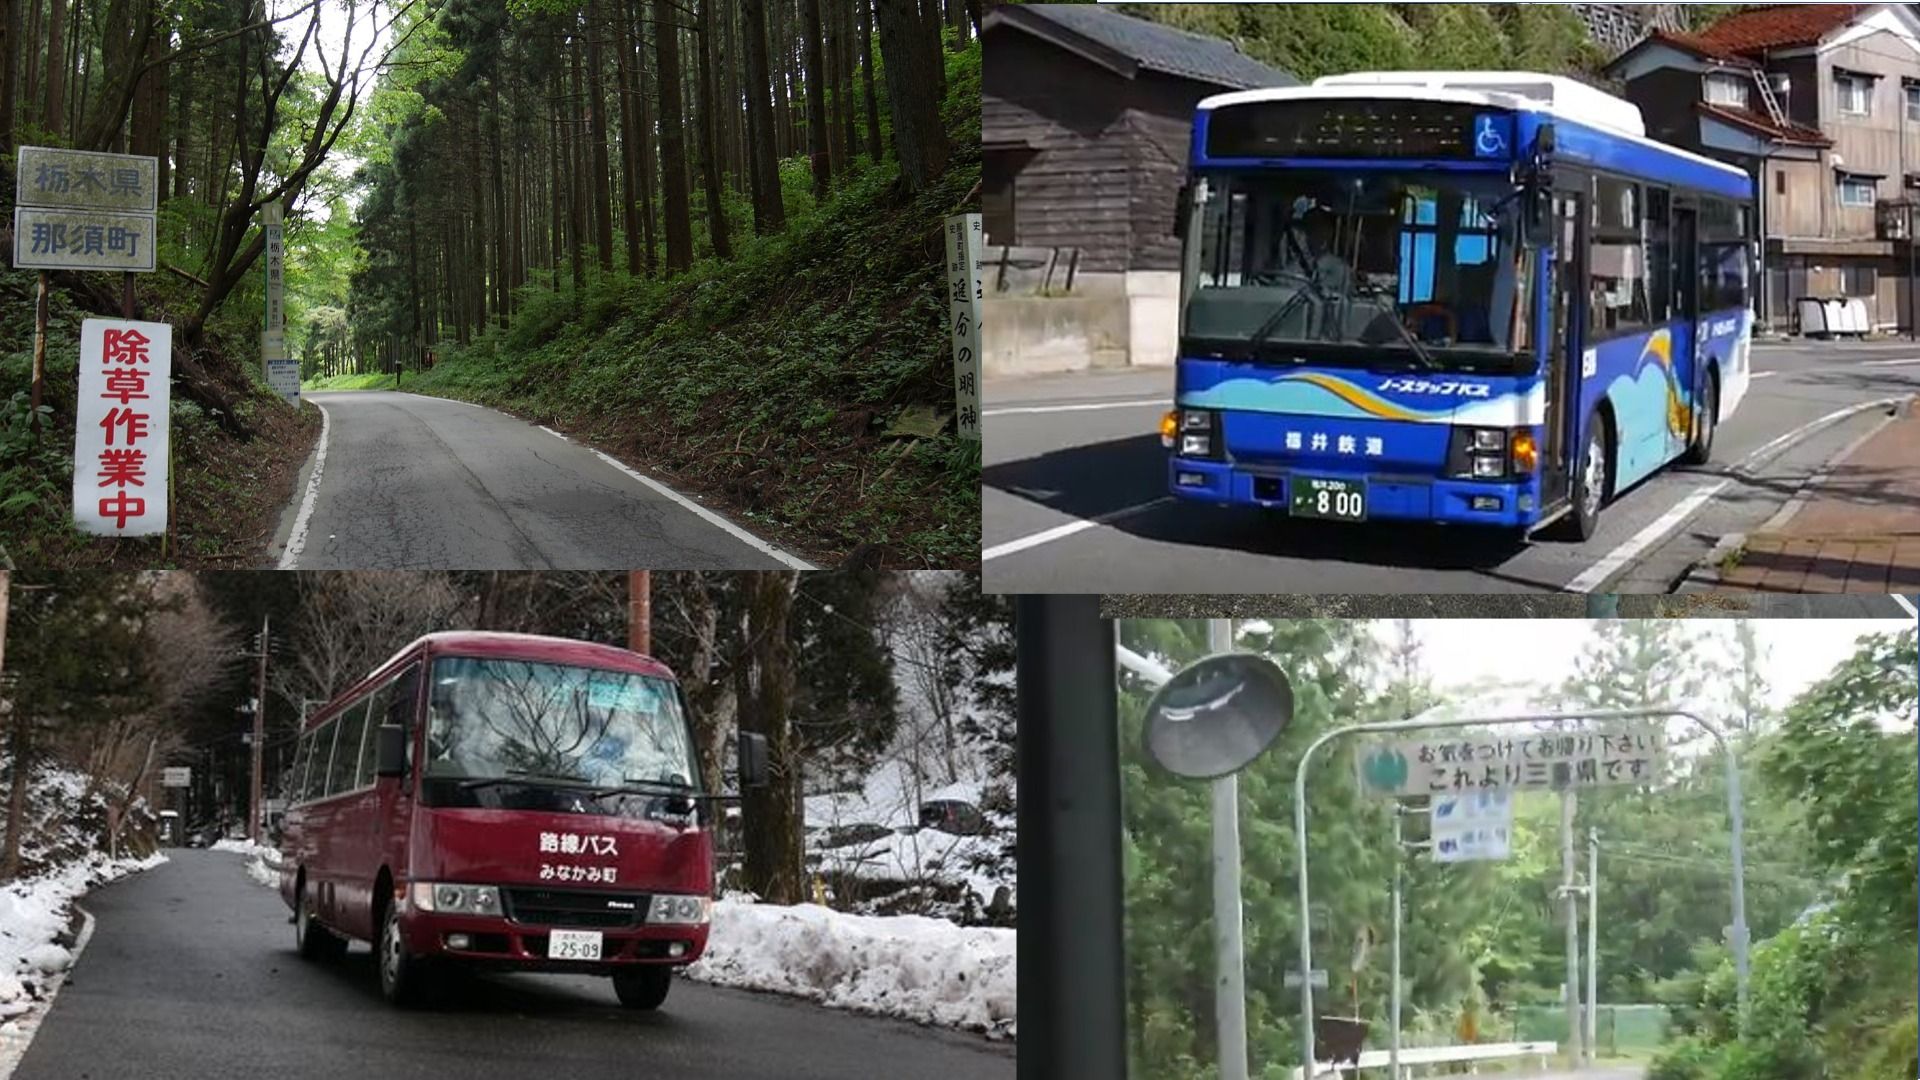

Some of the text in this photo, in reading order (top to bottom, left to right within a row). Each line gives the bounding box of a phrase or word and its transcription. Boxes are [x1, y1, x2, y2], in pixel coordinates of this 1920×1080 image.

[35, 162, 142, 198] 栃木県
[31, 222, 140, 257] 那須町
[269, 242, 280, 281] 栃木県
[1377, 379, 1490, 397] ノーステップバス
[97, 328, 151, 529] 除草作業中
[1286, 431, 1383, 456] 福井鉄道
[1429, 758, 1650, 791] これより三県です
[539, 832, 619, 856] 路線バス
[539, 864, 618, 883] みなかみ町
